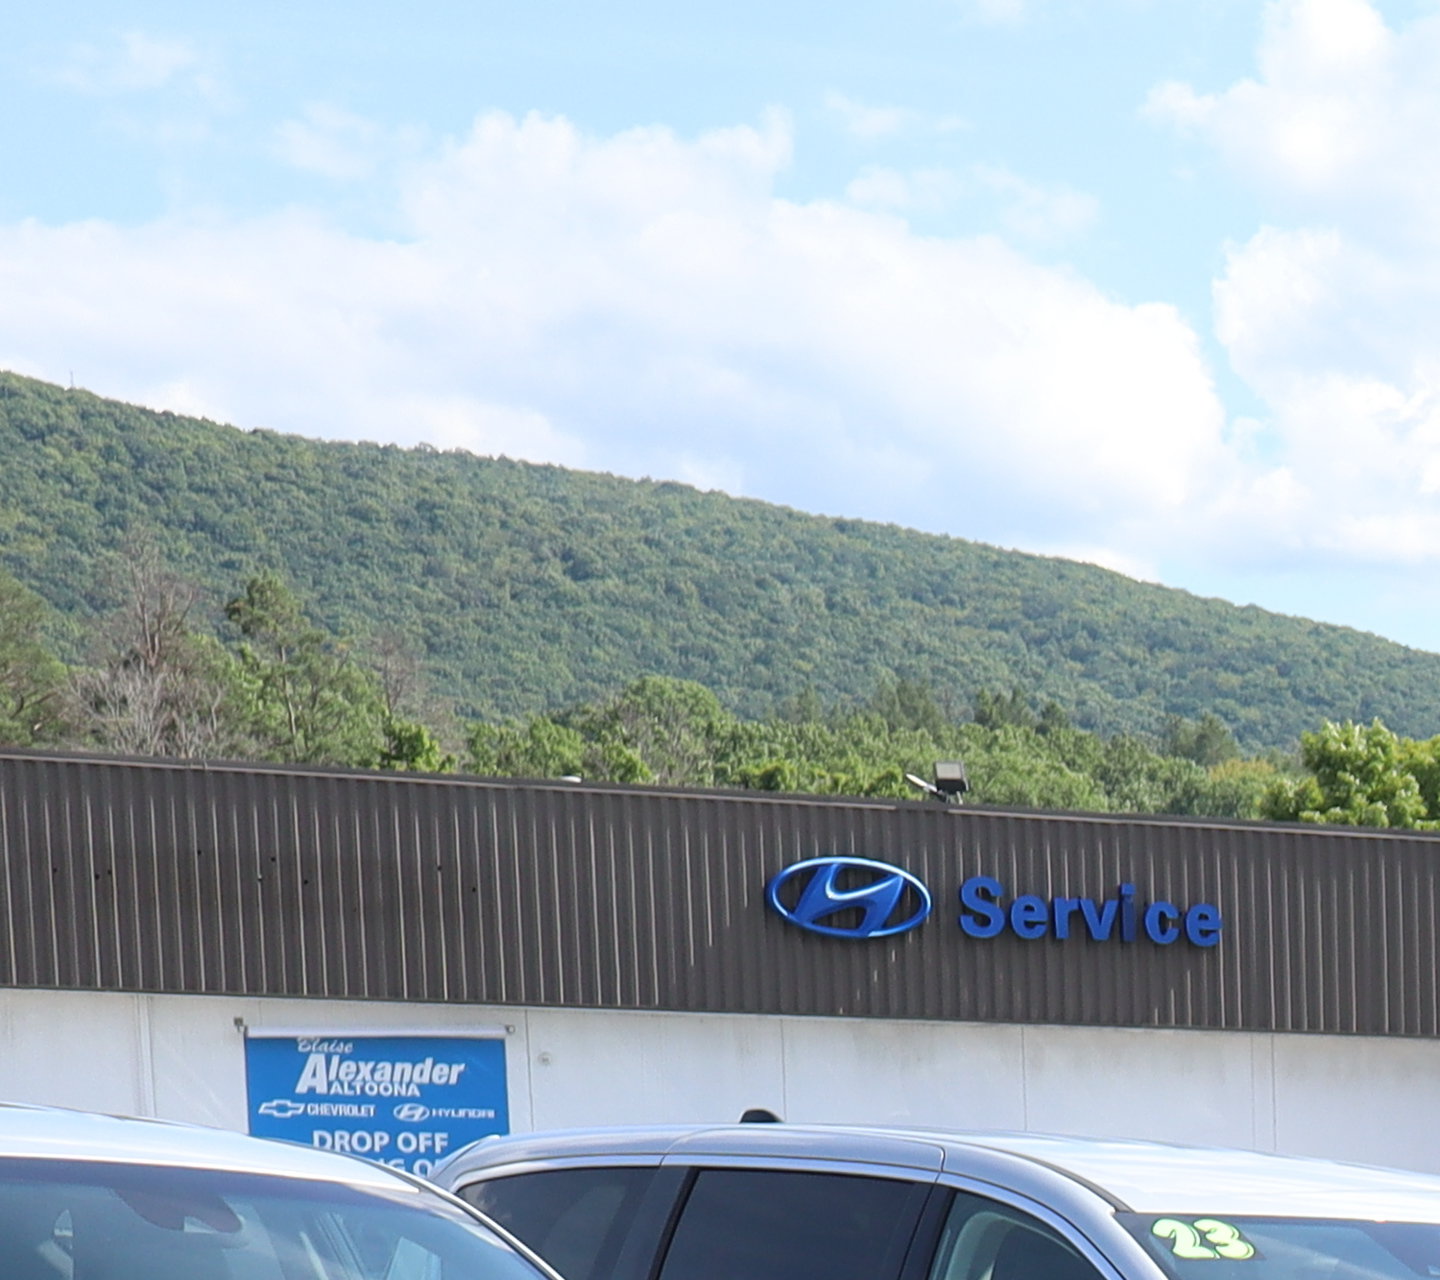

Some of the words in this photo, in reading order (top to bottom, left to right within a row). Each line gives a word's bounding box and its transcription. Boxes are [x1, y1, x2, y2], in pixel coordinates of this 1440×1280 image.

[959, 875, 1223, 947] Service
[297, 1037, 353, 1053] Blaise
[295, 1053, 465, 1094] Alexander
[329, 1081, 420, 1097] ALTOONA
[307, 1103, 375, 1117] CHEVROLET
[431, 1107, 495, 1118] HYUNDAI
[313, 1130, 390, 1152] DROP
[397, 1131, 448, 1153] OFF
[1152, 1218, 1255, 1259] 23
